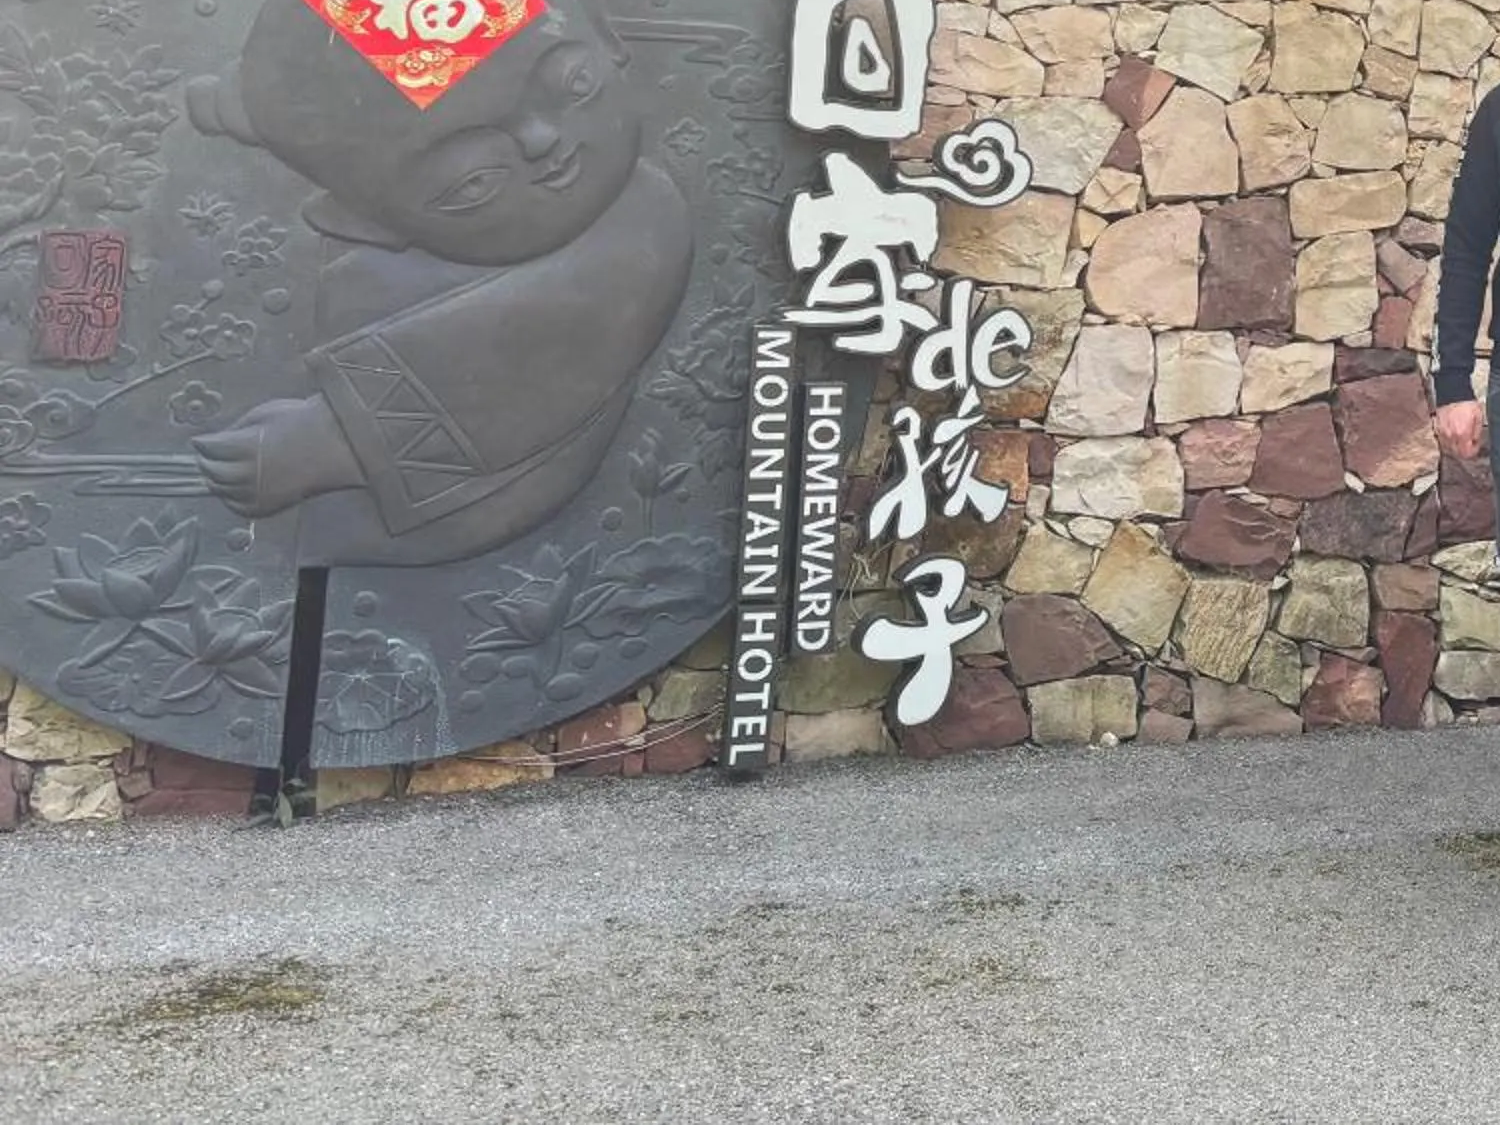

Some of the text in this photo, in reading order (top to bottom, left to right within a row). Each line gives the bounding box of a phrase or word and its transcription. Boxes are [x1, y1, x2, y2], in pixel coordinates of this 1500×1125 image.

[728, 330, 793, 766] MOUNTAIN HOTEL
[796, 386, 843, 651] HOMEWARD
